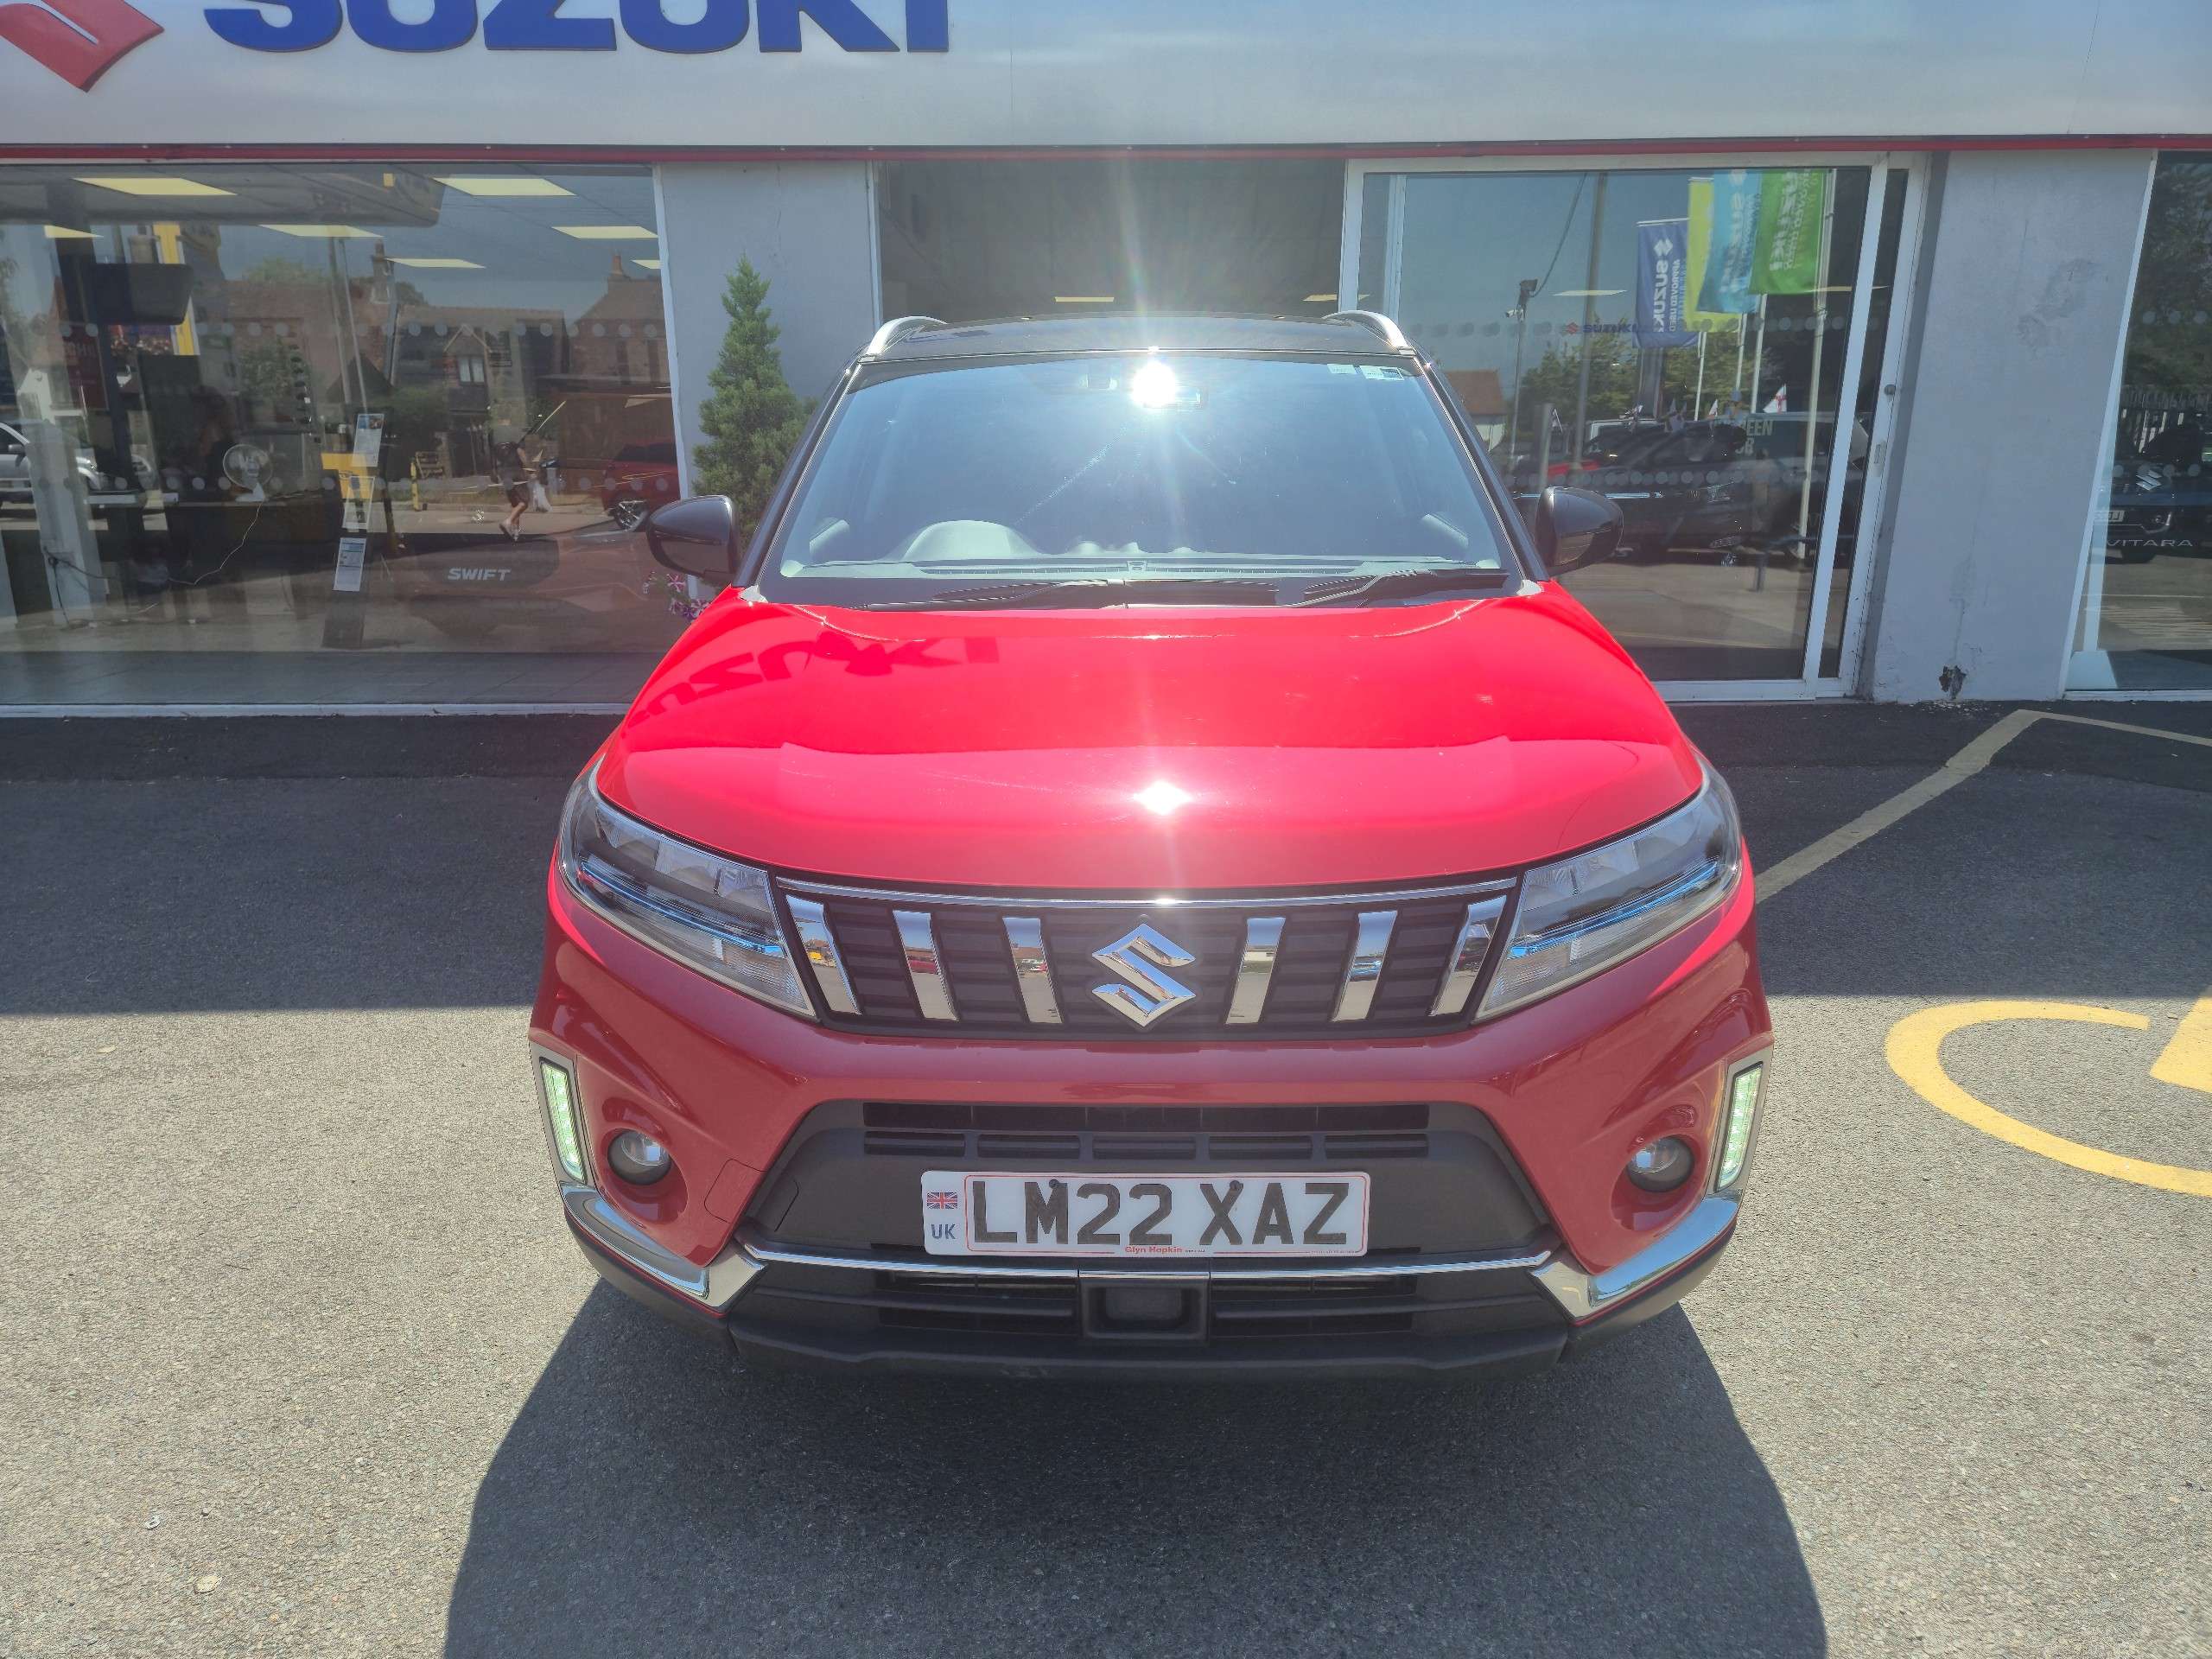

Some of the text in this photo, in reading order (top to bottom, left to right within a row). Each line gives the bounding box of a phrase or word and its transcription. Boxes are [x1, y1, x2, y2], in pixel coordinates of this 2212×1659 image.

[447, 568, 512, 581] SWIFT
[972, 1179, 1350, 1246] LM22 XAZ
[931, 1224, 957, 1240] UK
[1125, 1245, 1146, 1255] Glyn
[1149, 1245, 1183, 1255] Hopkin
